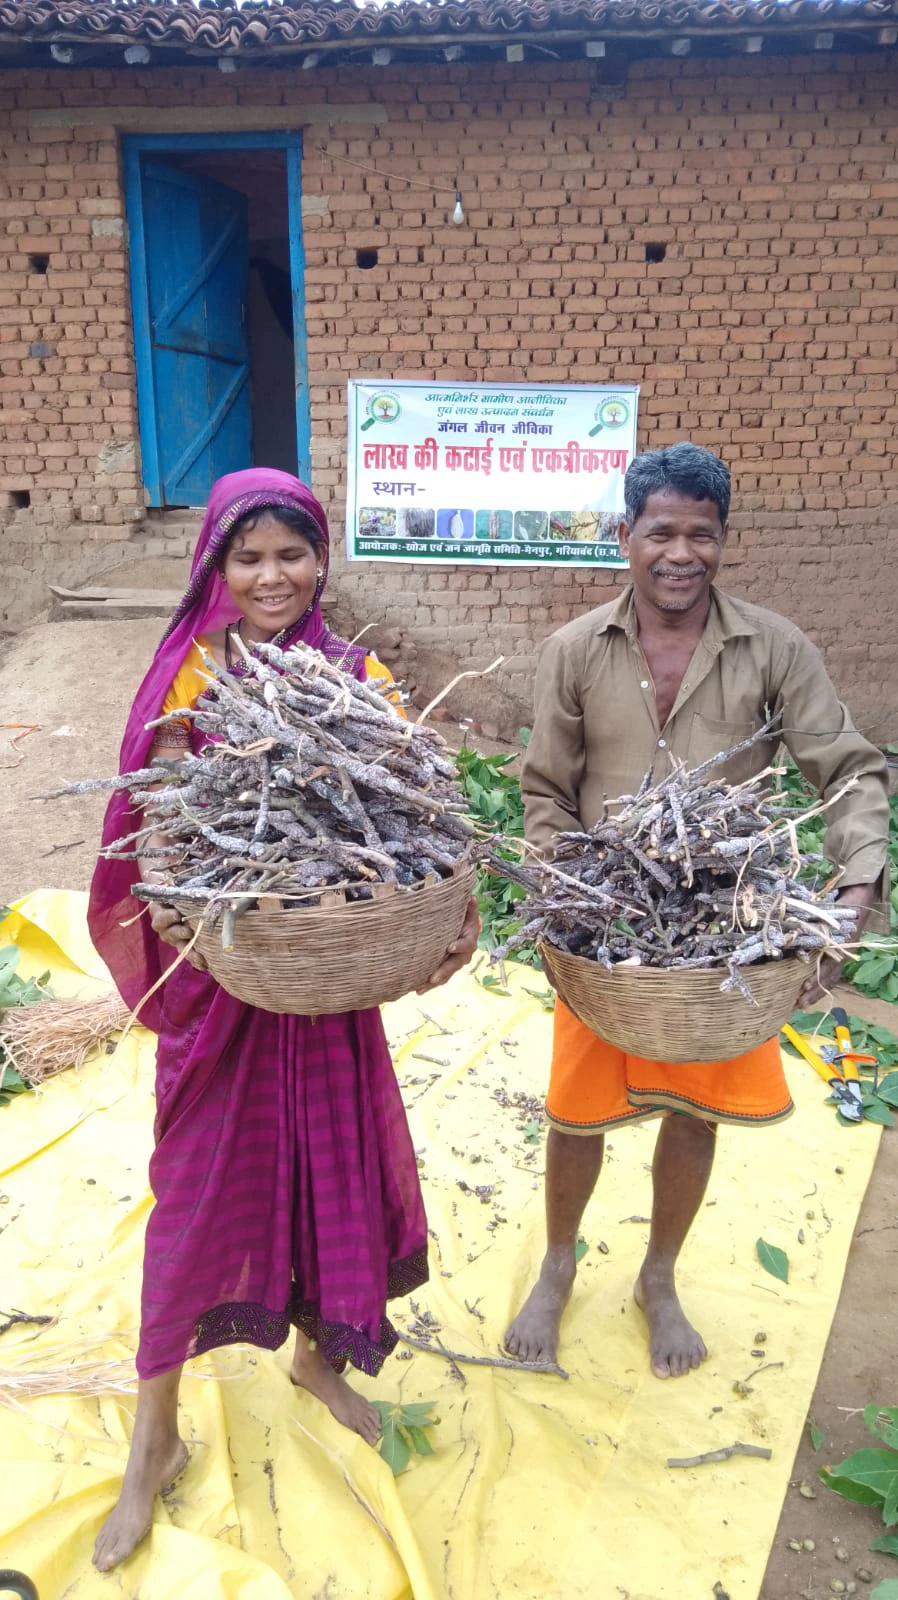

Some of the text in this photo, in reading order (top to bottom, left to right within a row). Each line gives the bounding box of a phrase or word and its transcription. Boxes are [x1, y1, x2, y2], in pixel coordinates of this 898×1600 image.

[437, 404, 454, 417] एवं
[455, 407, 478, 415] लाख
[481, 408, 519, 416] उत्पादन
[438, 419, 554, 435] जंगल जीवन जीविका
[363, 437, 629, 475] लाख की कटाई एवं एकत्रीकरण
[372, 481, 426, 496] स्थान-
[430, 541, 444, 552] एवं
[445, 544, 461, 553] जन
[463, 543, 492, 556] जागृति
[594, 545, 624, 559] (छ.ग.
